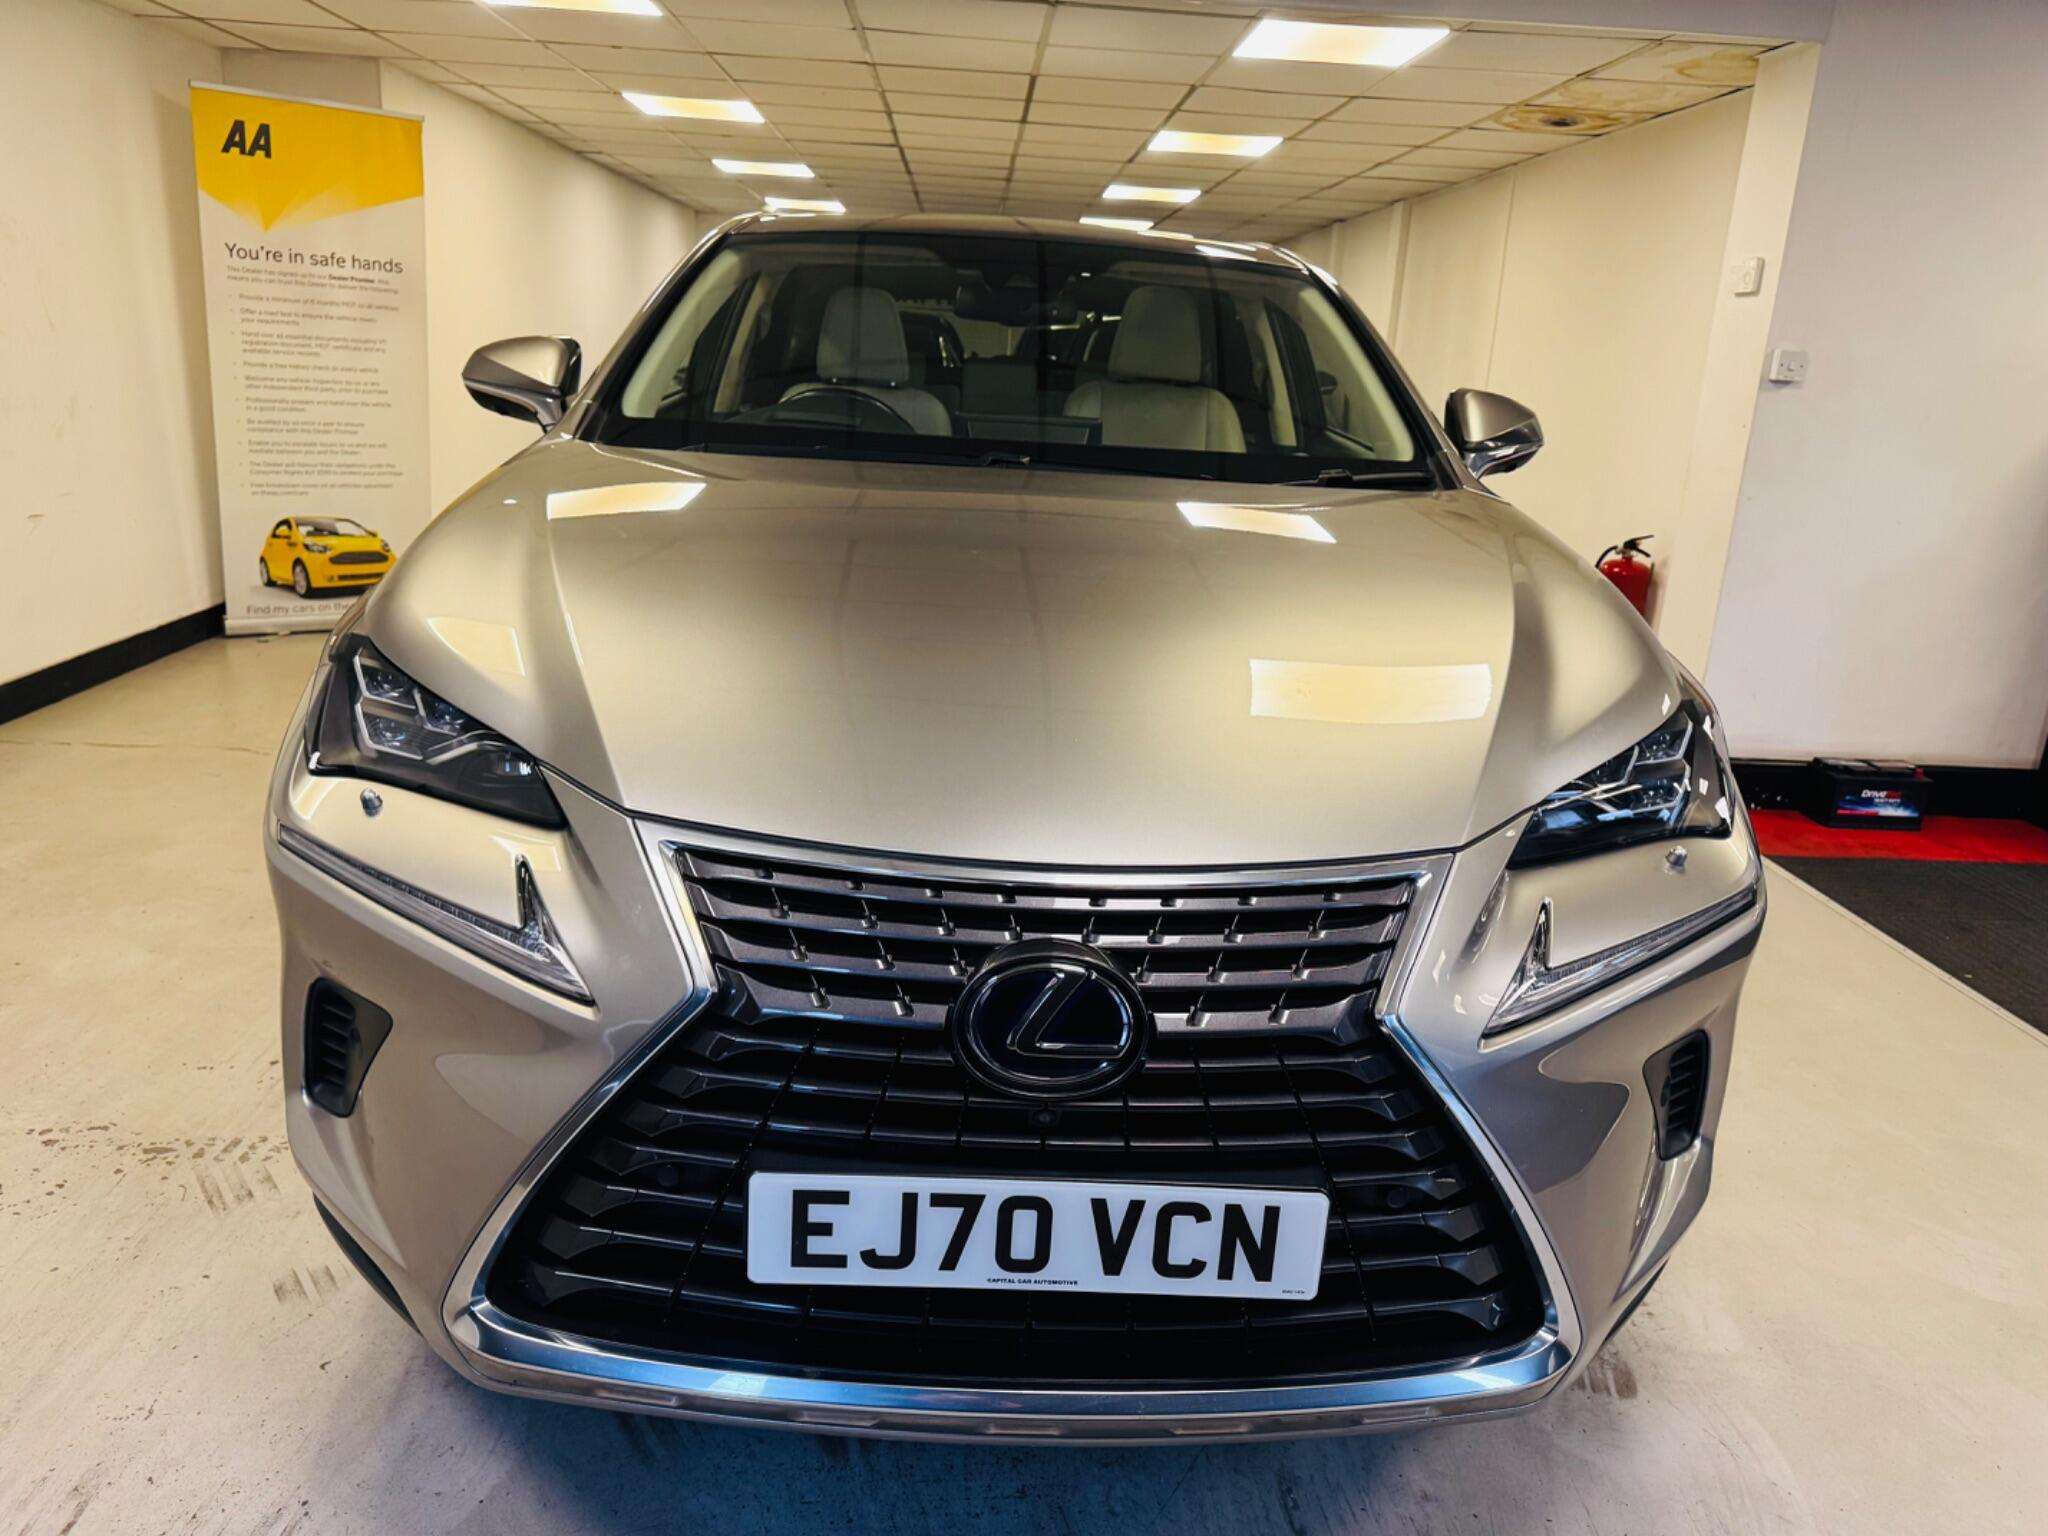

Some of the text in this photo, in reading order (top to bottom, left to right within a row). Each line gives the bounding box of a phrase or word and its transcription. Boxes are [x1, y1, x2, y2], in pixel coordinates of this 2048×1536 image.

[221, 119, 272, 159] AA
[224, 242, 404, 274] You're in safe hands
[246, 604, 271, 615] Find
[274, 605, 289, 616] my
[292, 604, 314, 613] cars
[318, 604, 332, 612] on
[790, 1188, 1281, 1283] EJ70 VCN
